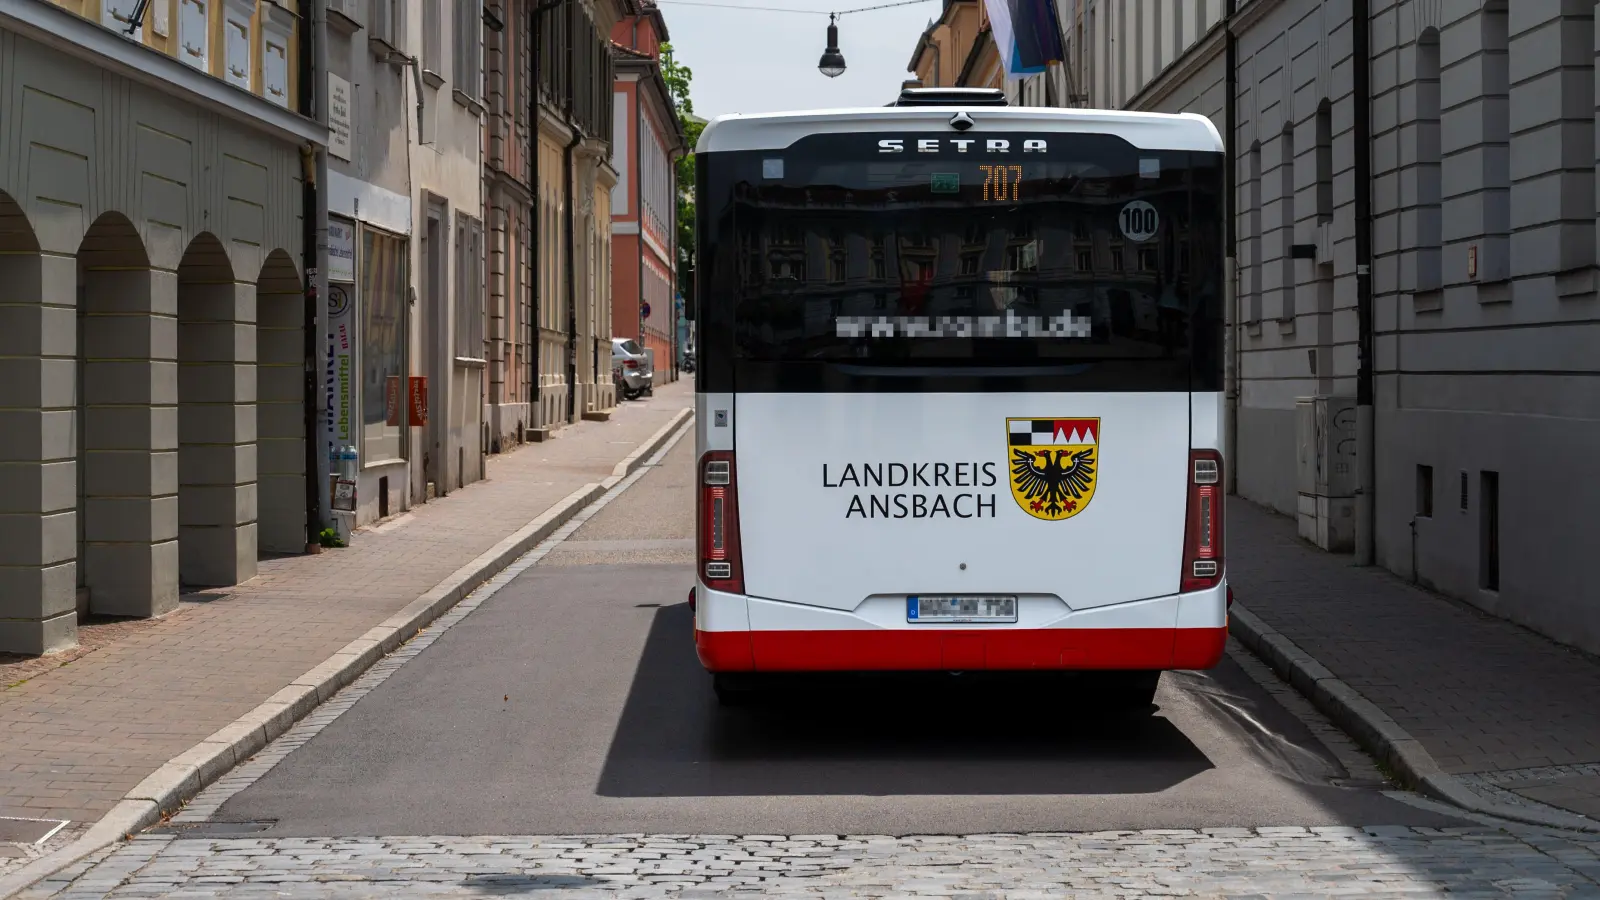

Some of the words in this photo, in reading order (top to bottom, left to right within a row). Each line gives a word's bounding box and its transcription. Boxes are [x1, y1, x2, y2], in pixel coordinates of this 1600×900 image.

[878, 139, 1048, 153] SETRA
[979, 165, 1023, 201] 707
[1122, 207, 1156, 234] 100
[337, 354, 349, 441] Lebensmittel
[822, 461, 997, 488] LANDKREIS
[845, 493, 996, 519] ANSBACH
